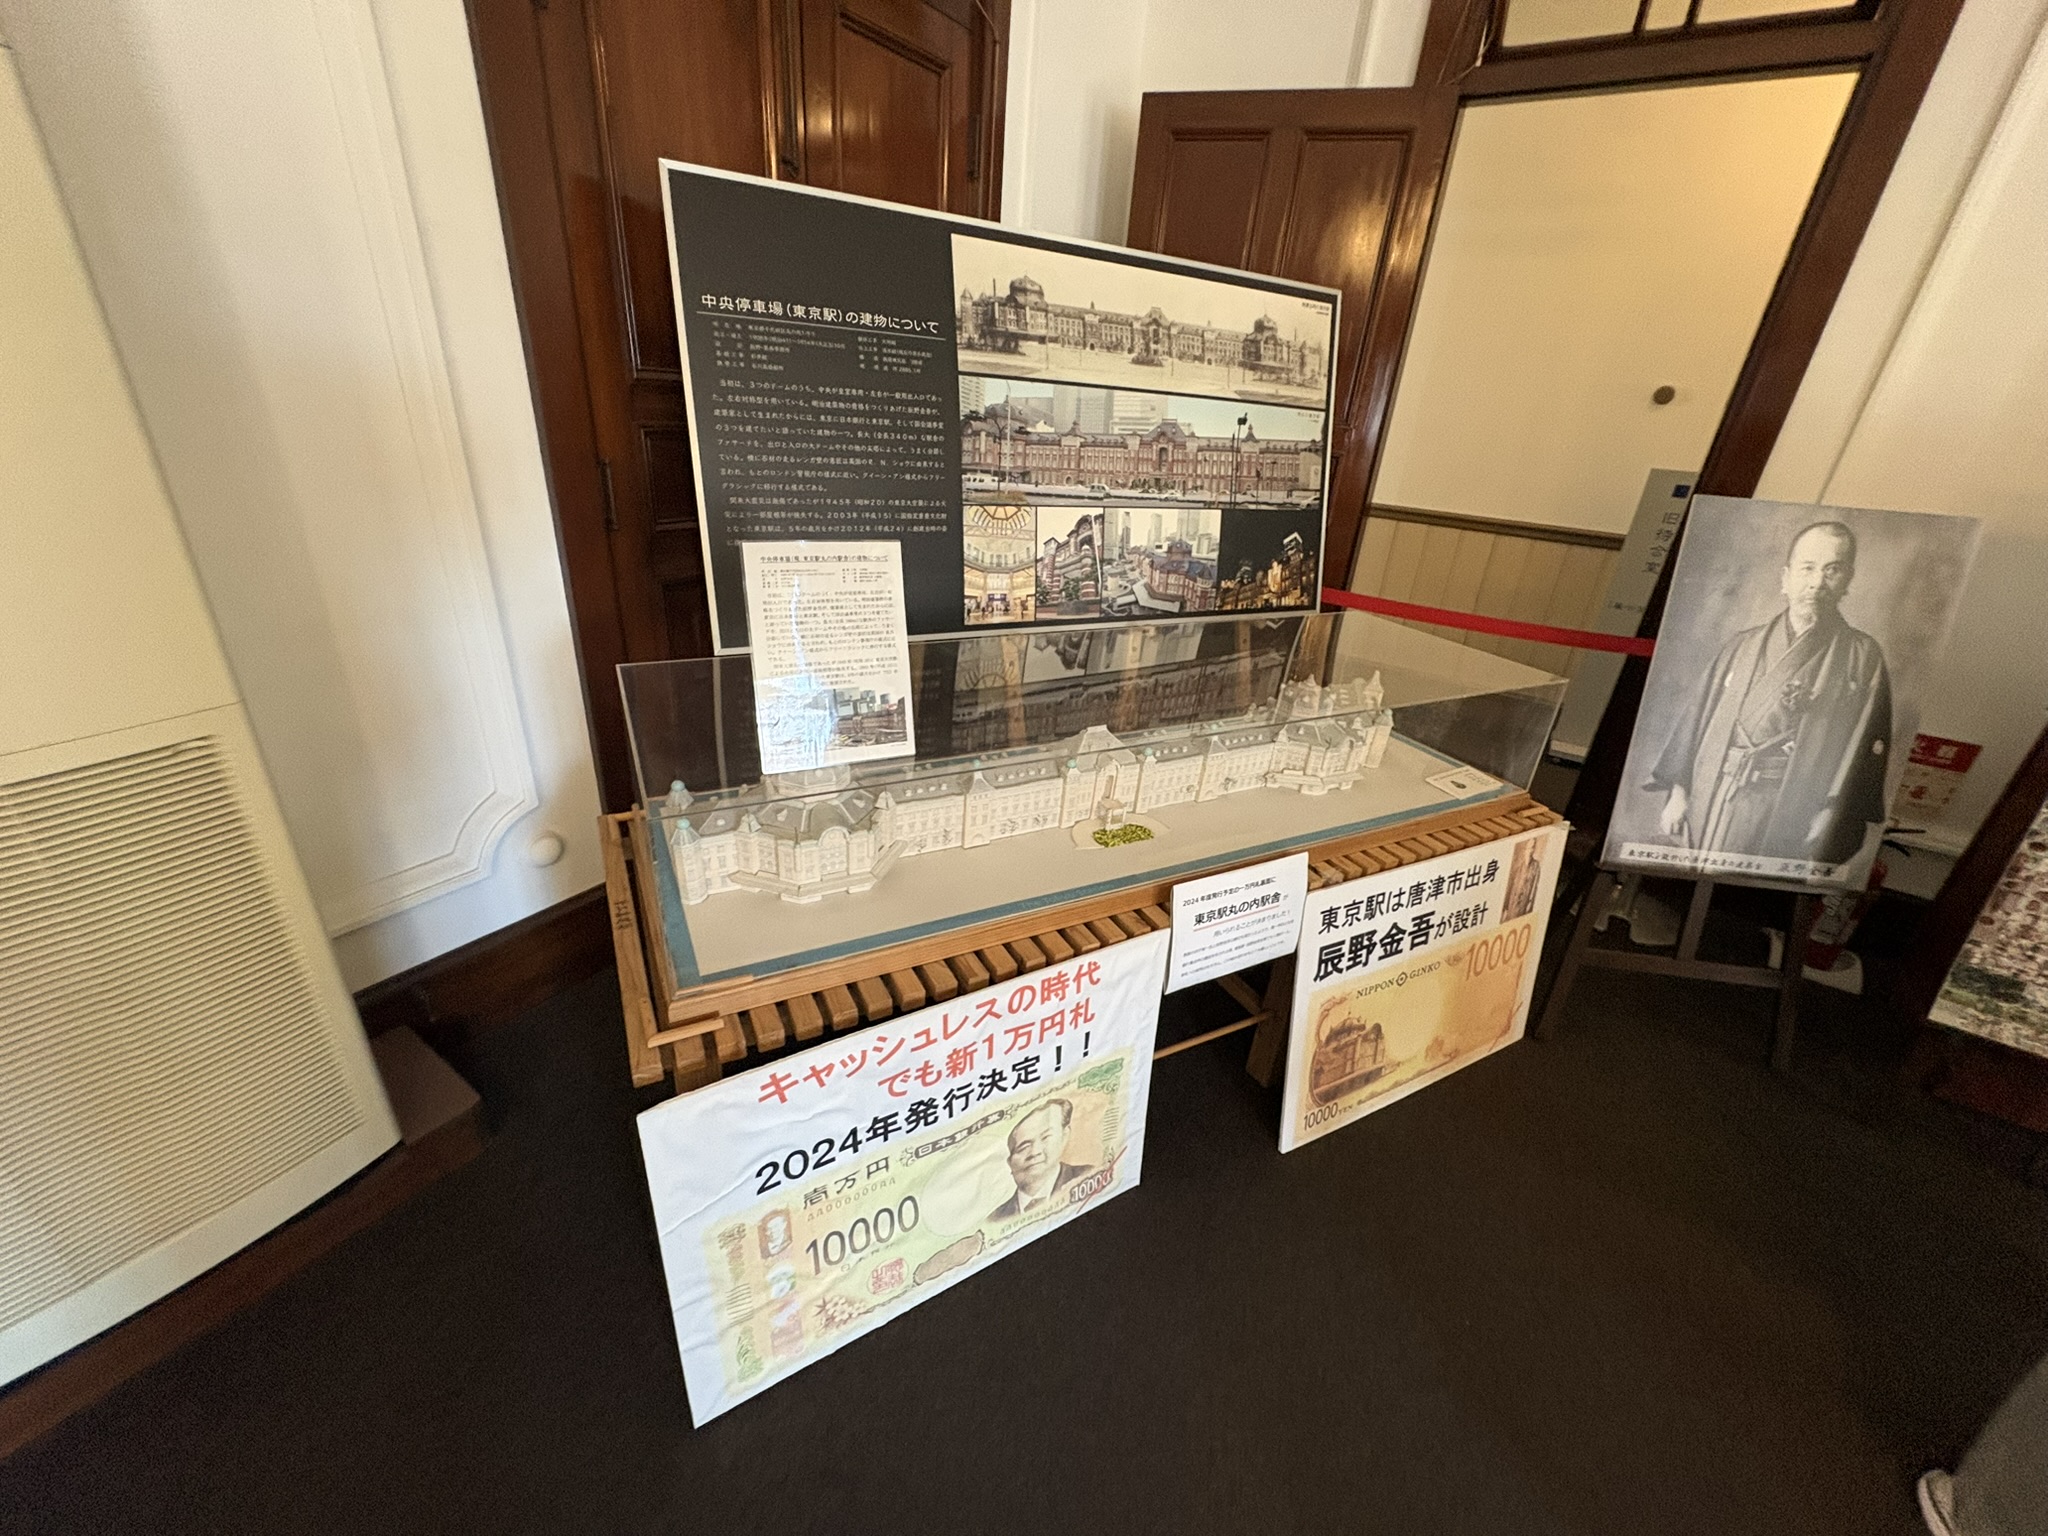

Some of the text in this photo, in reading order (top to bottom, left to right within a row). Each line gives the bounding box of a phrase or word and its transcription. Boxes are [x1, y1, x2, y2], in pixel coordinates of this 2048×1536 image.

[701, 293, 940, 334] 中央停車場(東京駅)の建物について
[1318, 859, 1500, 935] 東京駅は唐津市出身
[1313, 901, 1489, 982] 辰野金吾が設計
[1465, 923, 1532, 981] 10000
[1356, 961, 1441, 999] NIPPON GINKO
[758, 961, 1102, 1105] キャッシュレスの時代
[878, 998, 1096, 1098] でも新1万円札
[755, 1031, 1092, 1196] 2024年発行決定!!
[1303, 1102, 1338, 1131] 10000
[803, 1156, 890, 1209] 壱万円
[805, 1195, 920, 1276] 10000
